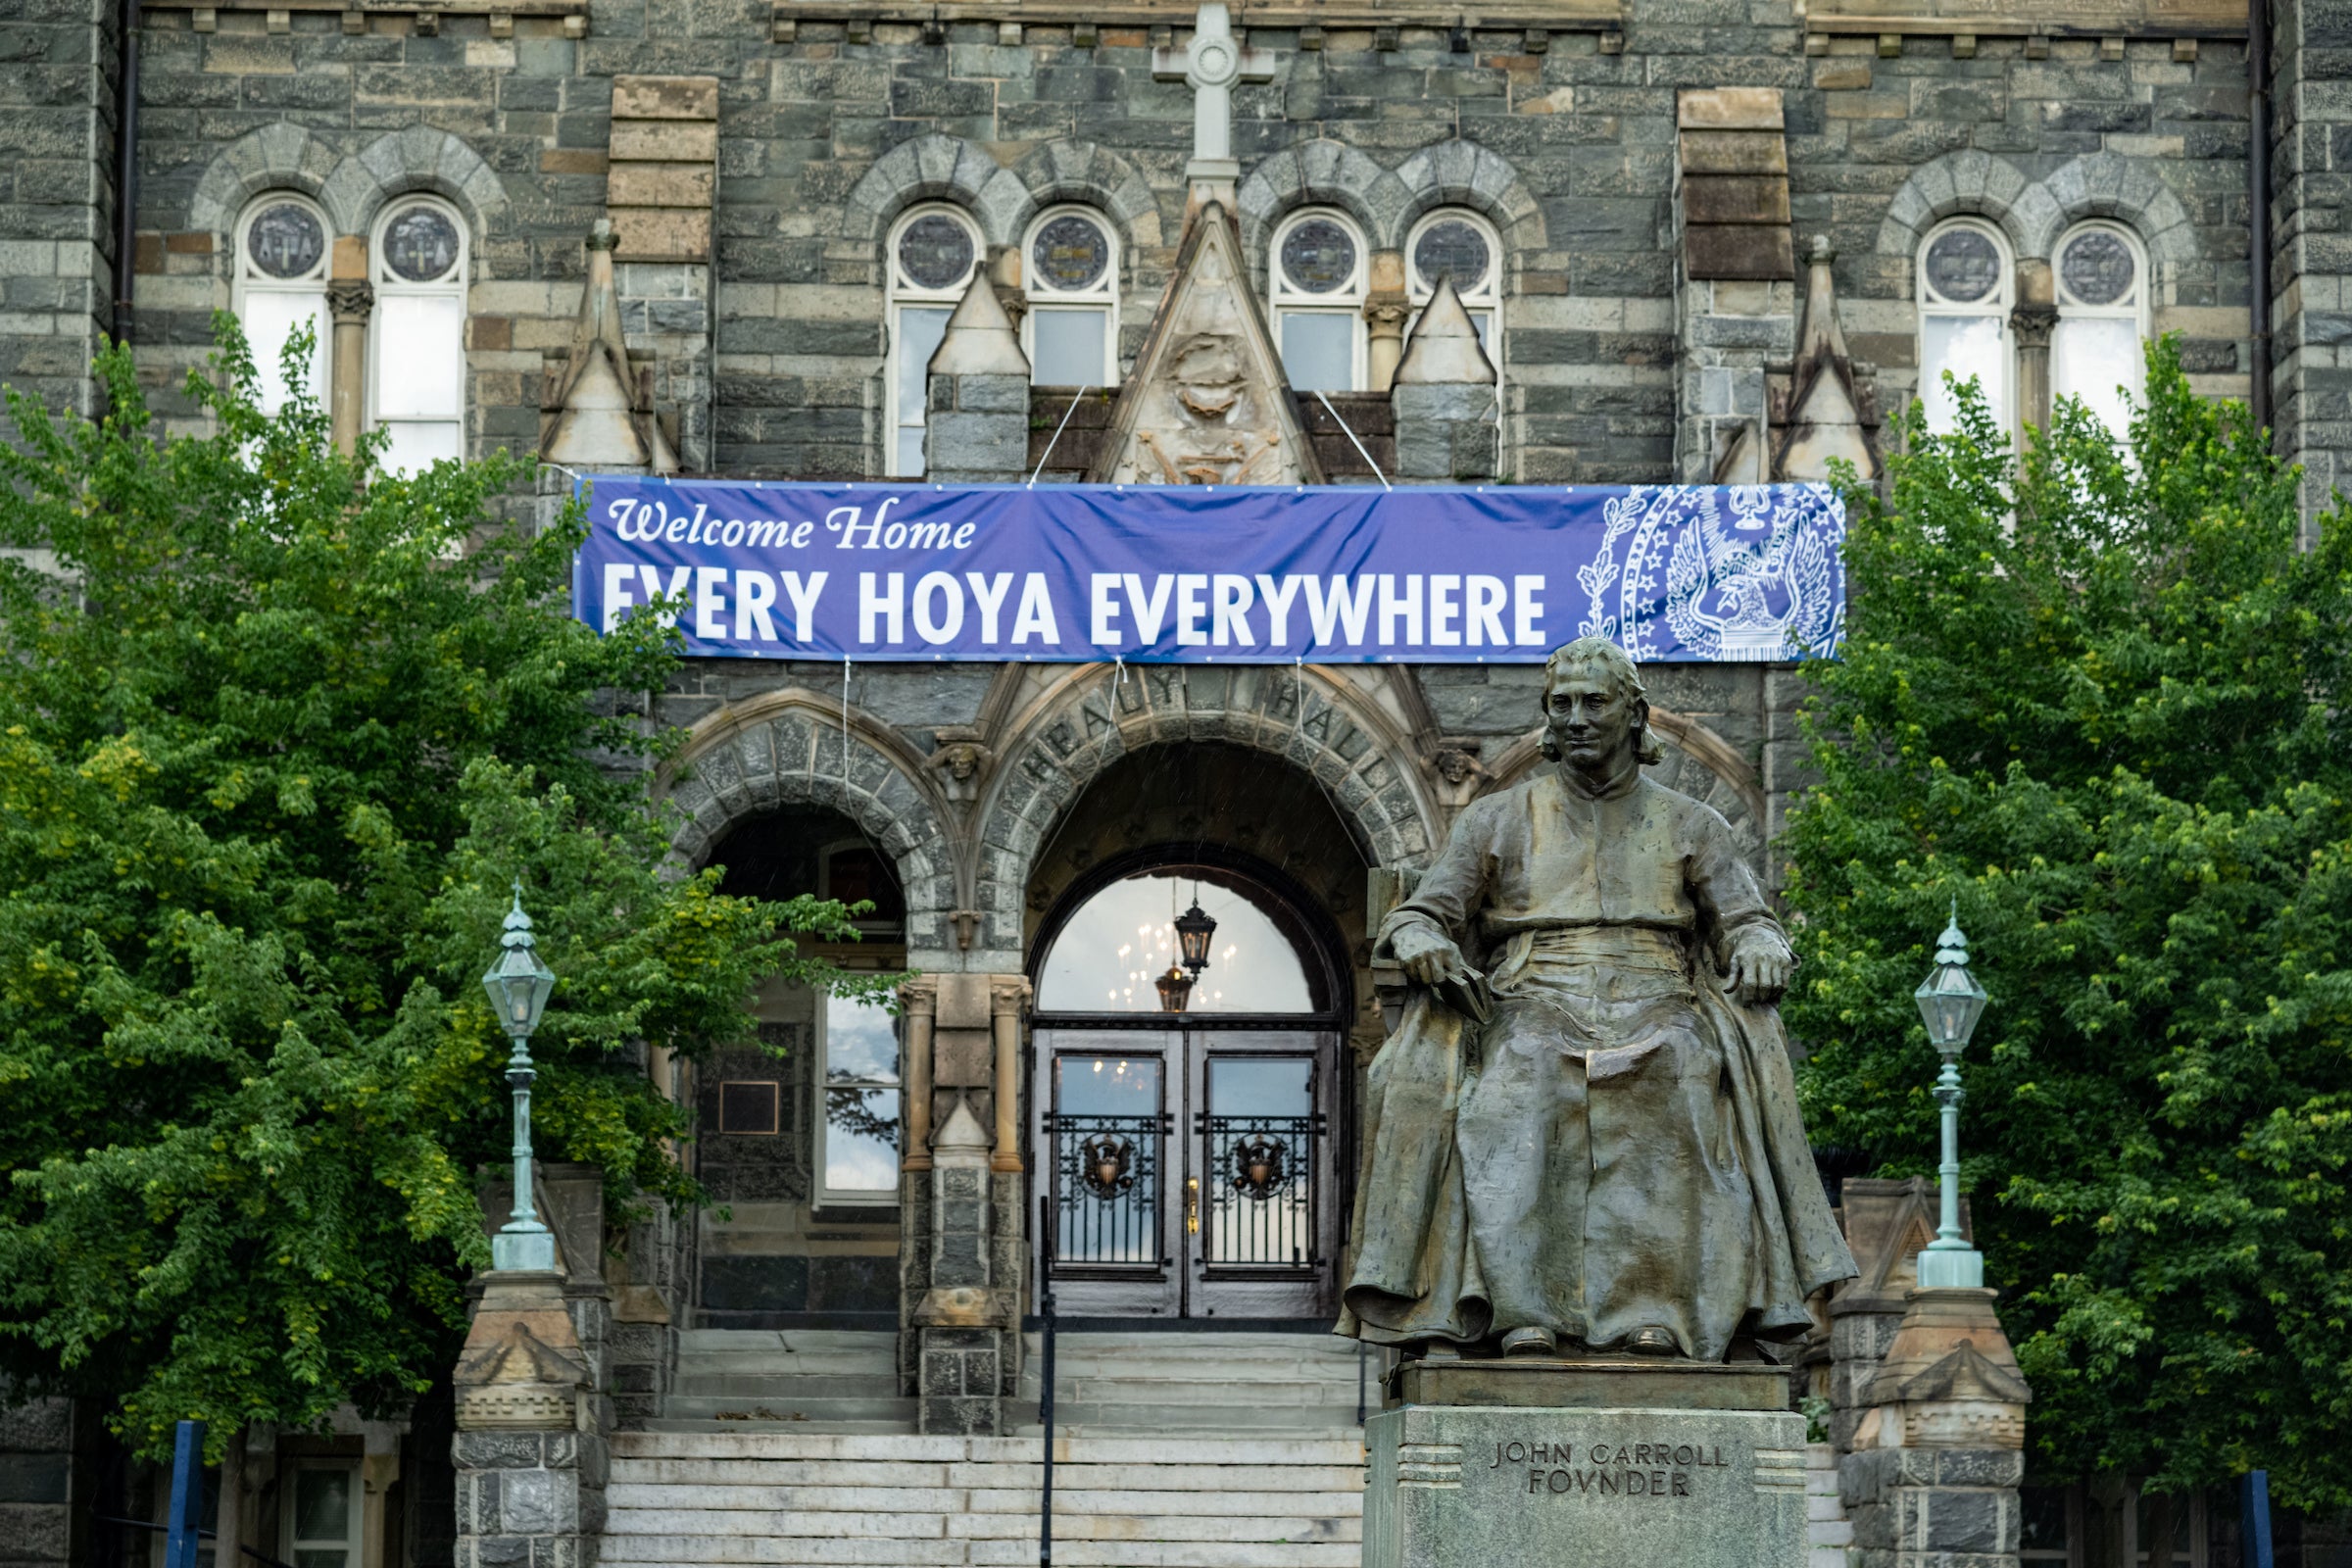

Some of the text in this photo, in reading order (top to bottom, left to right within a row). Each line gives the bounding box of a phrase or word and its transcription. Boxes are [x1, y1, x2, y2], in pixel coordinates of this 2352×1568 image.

[609, 497, 977, 550] Welcome Home
[603, 564, 829, 643] EVERY
[858, 570, 1060, 645] HOYA
[1091, 573, 1545, 647] EVERYWHERE
[1021, 670, 1385, 789] HEALY HALL
[1490, 1442, 1730, 1469] JOHN CARROLL
[1528, 1469, 1690, 1496] FOVNDER
